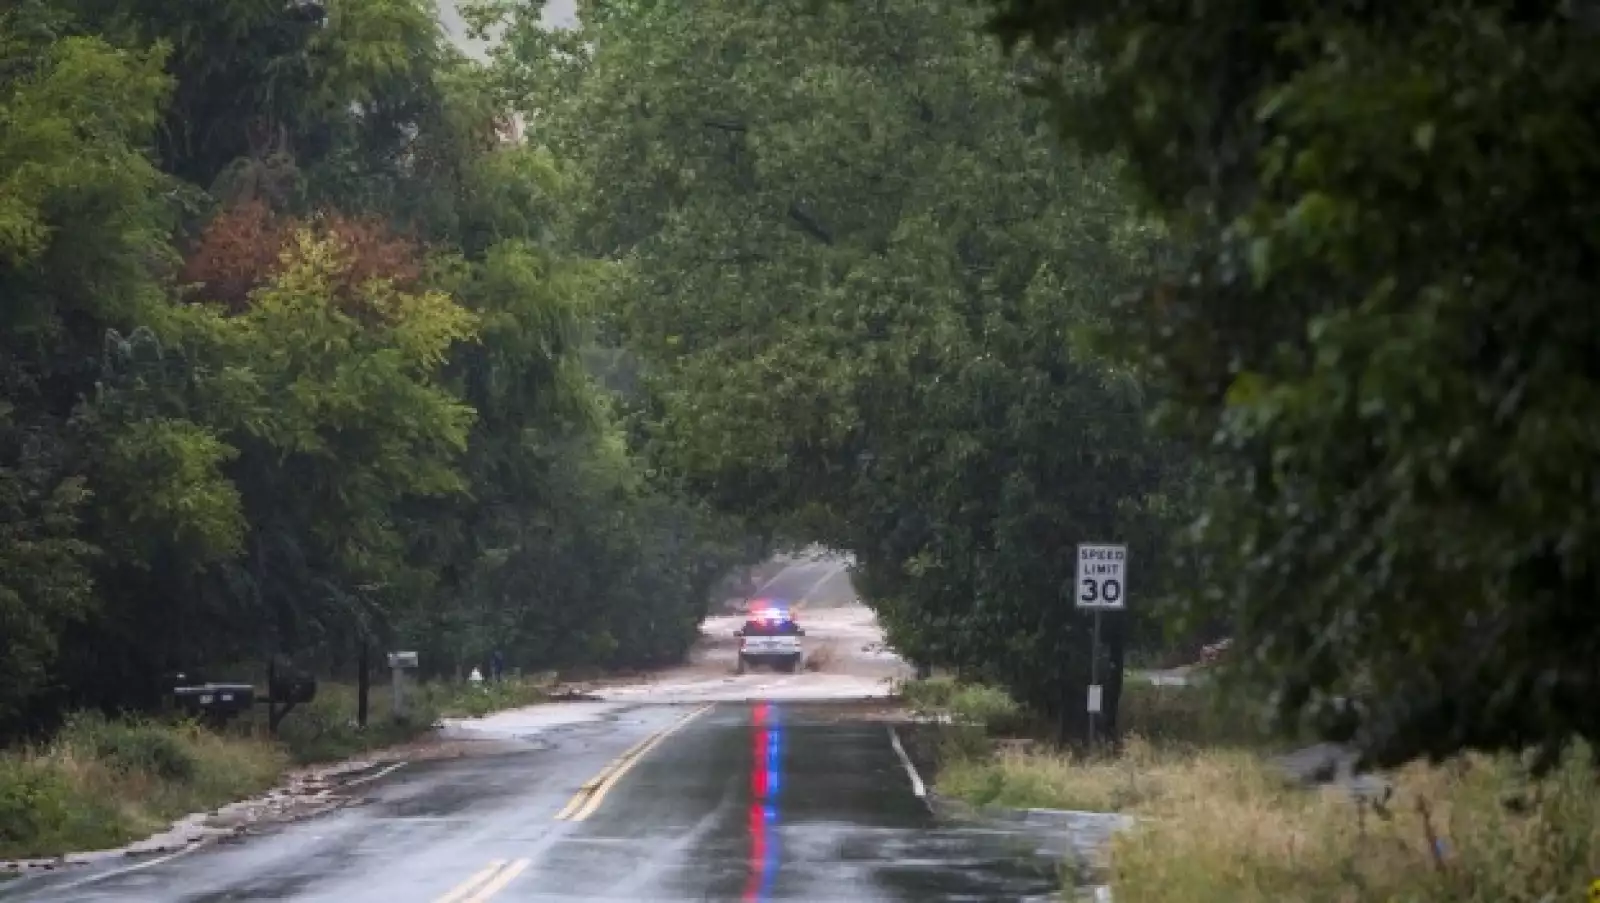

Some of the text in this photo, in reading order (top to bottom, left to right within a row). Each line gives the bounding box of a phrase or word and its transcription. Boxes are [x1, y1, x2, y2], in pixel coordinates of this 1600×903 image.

[1081, 549, 1124, 560] SPEED
[1084, 563, 1119, 575] LIMIT
[1081, 579, 1120, 602] 30
